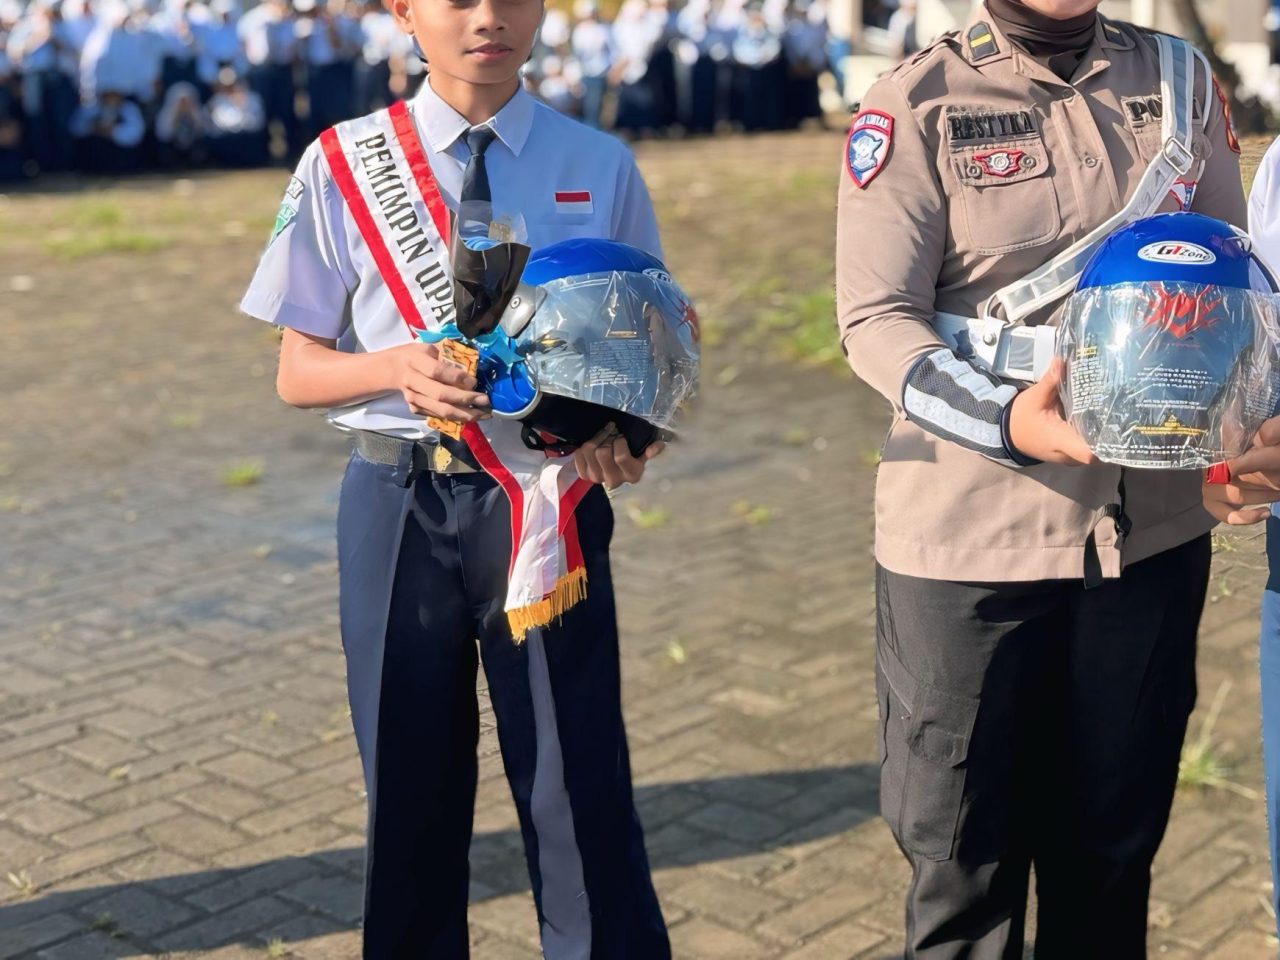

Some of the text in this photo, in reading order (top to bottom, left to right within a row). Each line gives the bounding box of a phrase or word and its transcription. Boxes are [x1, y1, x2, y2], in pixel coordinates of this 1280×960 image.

[951, 112, 1036, 140] RESTYKA
[355, 132, 456, 325] PEMIMPIN UPA
